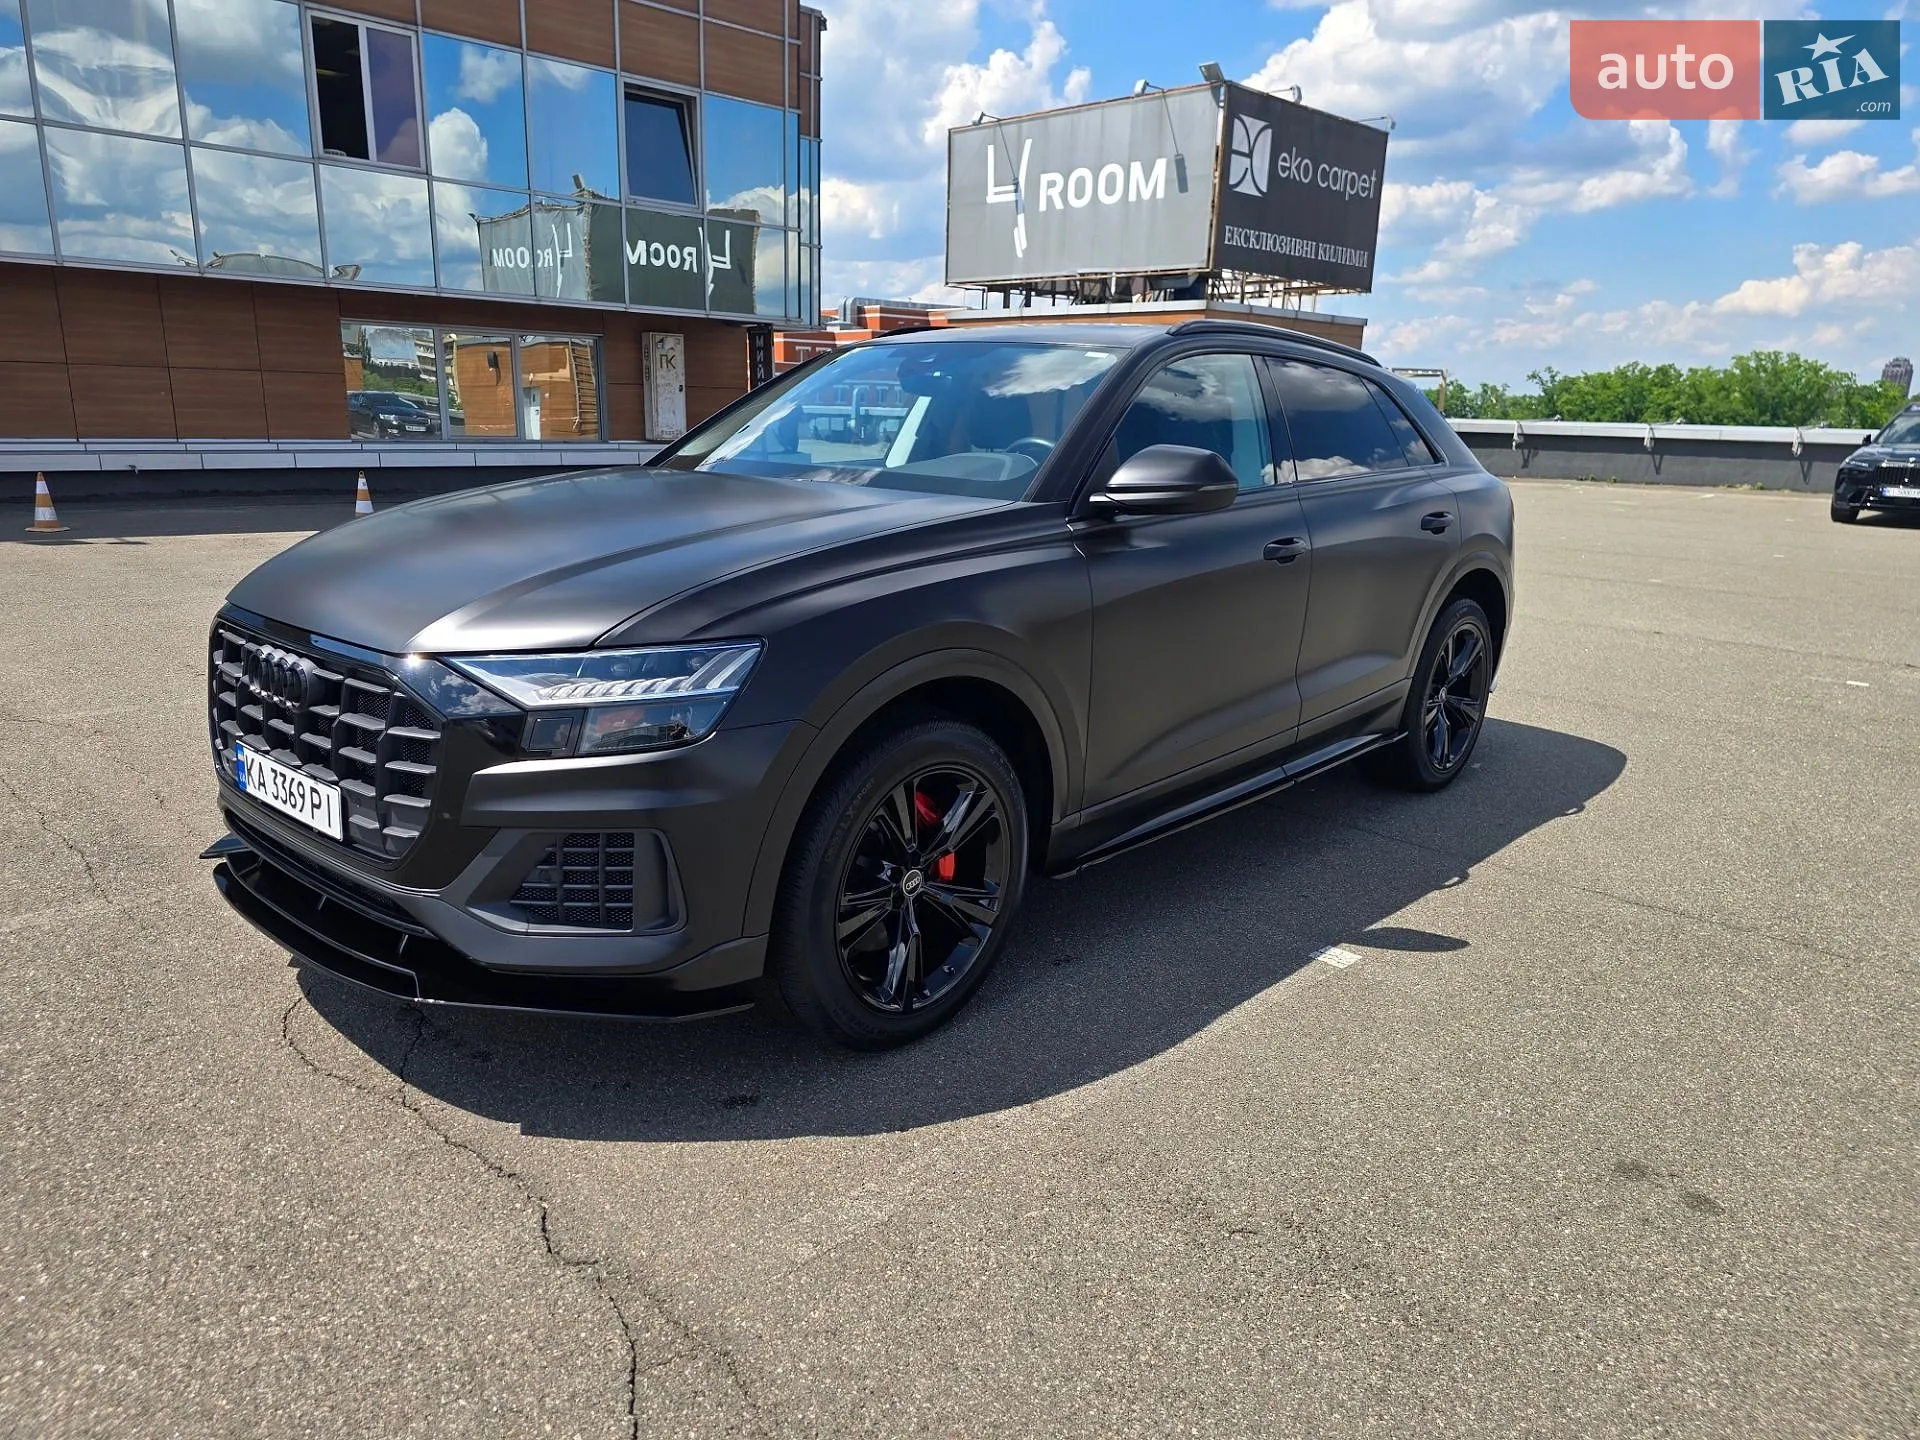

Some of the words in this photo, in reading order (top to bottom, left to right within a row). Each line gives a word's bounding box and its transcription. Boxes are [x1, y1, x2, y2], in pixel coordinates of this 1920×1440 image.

[1038, 157, 1167, 212] ROOM
[1277, 146, 1313, 184] eko
[1317, 163, 1377, 201] carpet
[1223, 225, 1317, 260] ЕКСКЛЮЗИВНІ
[1317, 242, 1369, 268] КИЛИМИ
[659, 354, 676, 369] ПК
[755, 335, 765, 386] МИЙ
[270, 768, 306, 813] 3369
